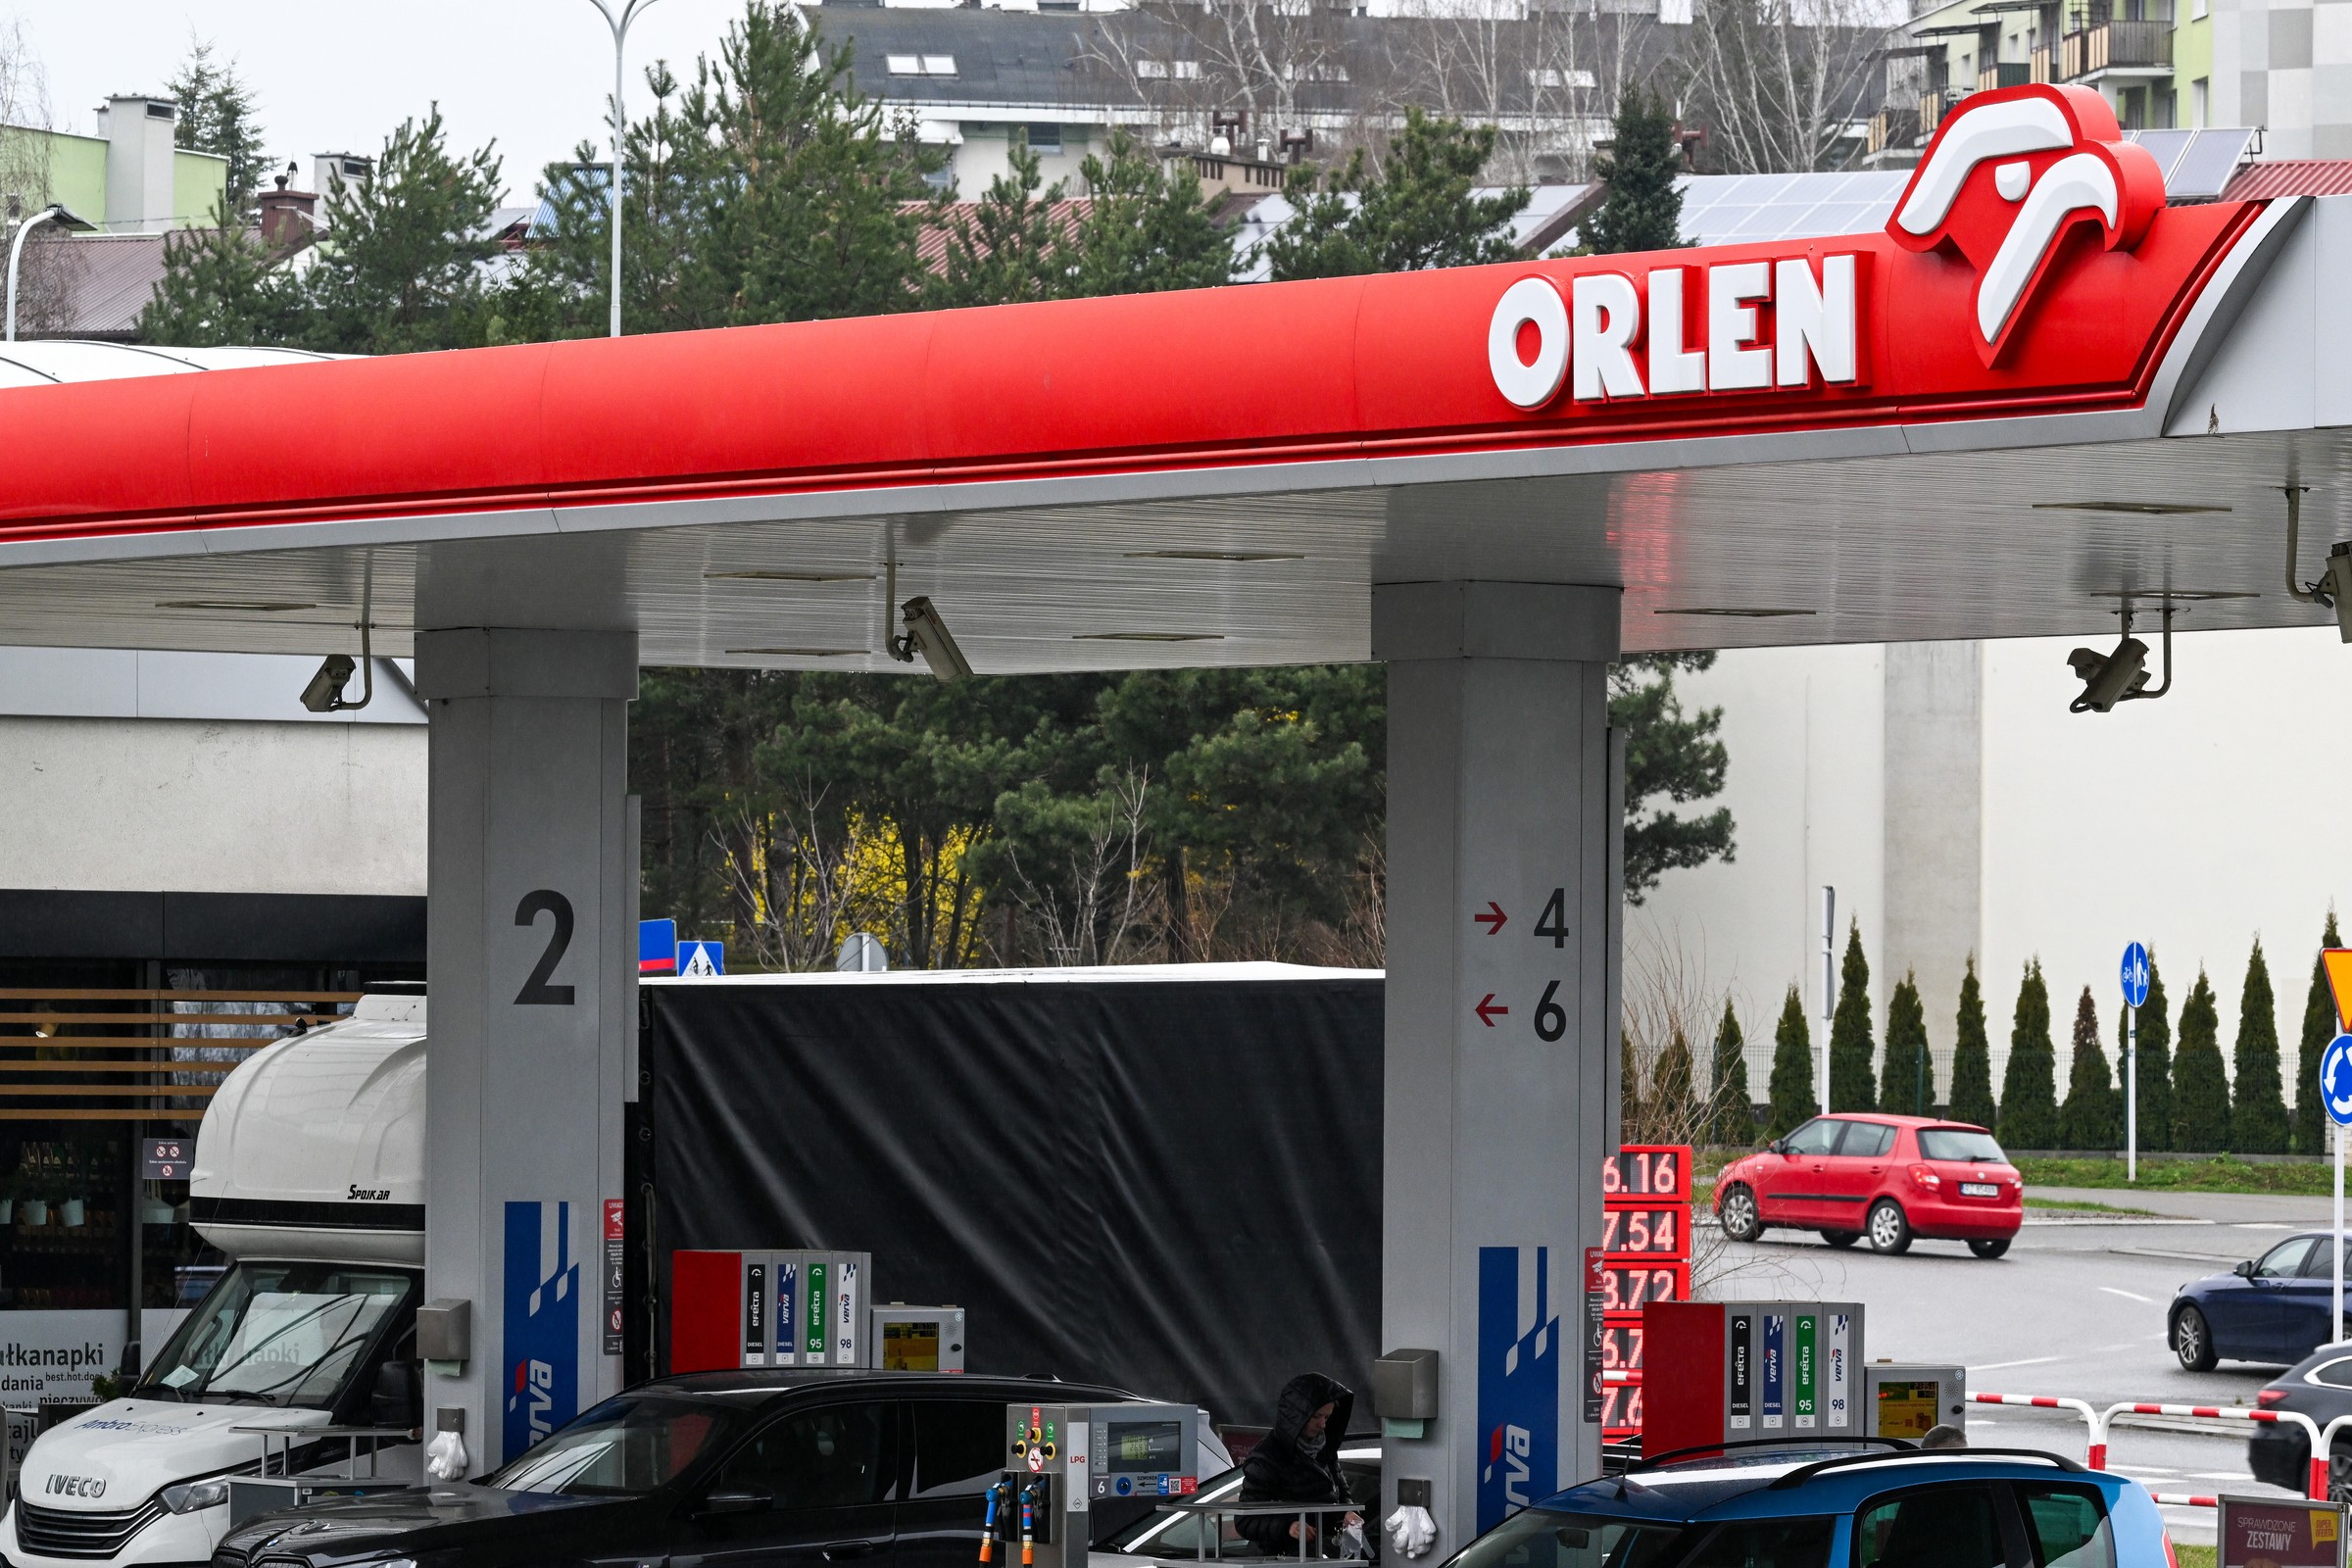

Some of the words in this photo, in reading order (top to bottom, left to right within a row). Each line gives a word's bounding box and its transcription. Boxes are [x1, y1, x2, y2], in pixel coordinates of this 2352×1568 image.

[1488, 253, 1857, 408] ORLEN
[1534, 888, 1569, 949] 4
[513, 889, 575, 1005] 2
[1534, 980, 1567, 1042] 6
[1603, 1153, 1676, 1194] 6.16
[1603, 1211, 1675, 1251] 7.54
[1603, 1269, 1675, 1309] 3.72
[809, 1339, 822, 1348] 95
[840, 1339, 852, 1348] 98
[1603, 1329, 1642, 1368] 6.7
[2, 1375, 44, 1391] dania
[529, 1359, 553, 1448] rva
[1798, 1399, 1812, 1411] 95
[1832, 1398, 1844, 1410] 98
[1070, 1455, 1086, 1464] LPG
[1505, 1424, 1531, 1518] rva
[45, 1473, 107, 1498] IVECO
[1098, 1481, 1105, 1494] 6
[2237, 1517, 2296, 1533] SPRAWDZONE
[2246, 1530, 2292, 1551] ZESTAWY
